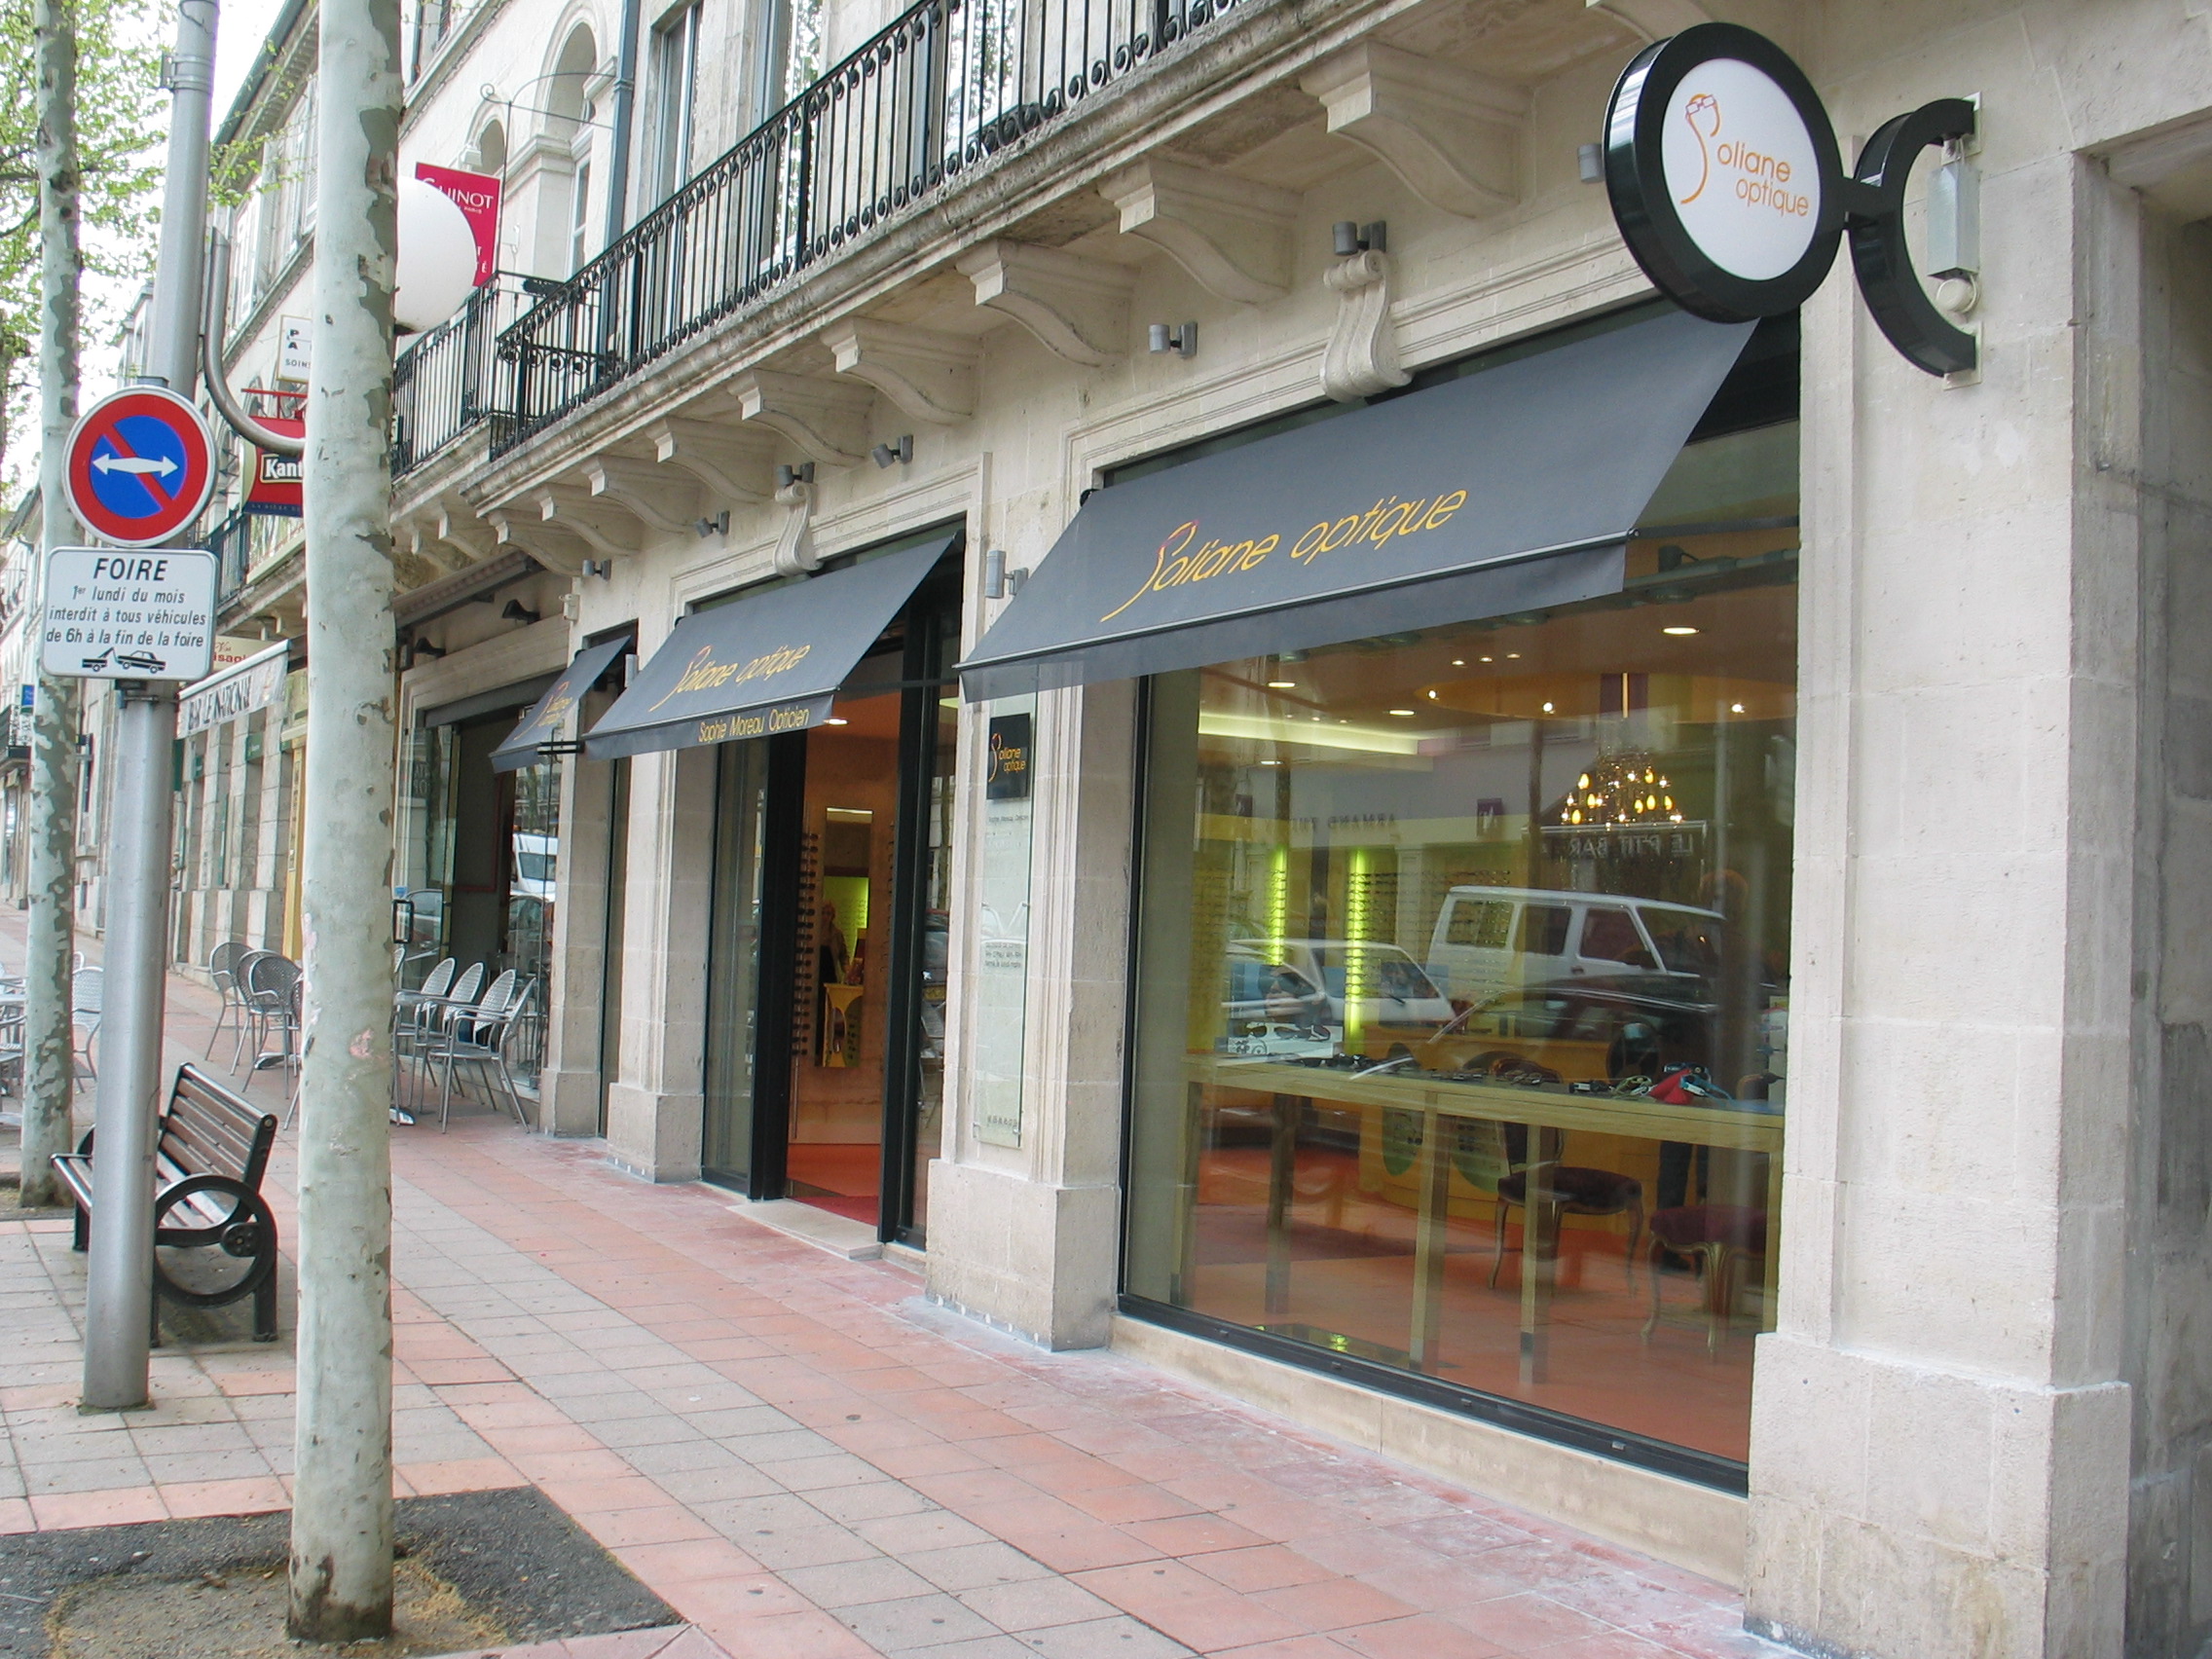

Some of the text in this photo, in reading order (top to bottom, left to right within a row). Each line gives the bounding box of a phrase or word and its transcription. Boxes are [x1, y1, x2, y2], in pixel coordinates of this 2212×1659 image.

[1735, 178, 1809, 217] optique
[285, 358, 311, 369] SOIN
[1290, 489, 1468, 566] optique
[92, 557, 168, 581] FOIRE
[72, 584, 186, 604] 1er lundi du mois
[49, 606, 207, 626] interdit à tous véhicules
[46, 628, 61, 643] de
[65, 628, 83, 644] 6h
[86, 629, 95, 644] à
[99, 629, 111, 645] la
[115, 630, 134, 645] fin
[137, 631, 154, 646] de
[158, 632, 170, 646] la
[173, 632, 204, 647] foire
[734, 644, 812, 688] optique
[698, 707, 811, 744] Sophie Moreau Opticien
[1003, 759, 1026, 775] optique
